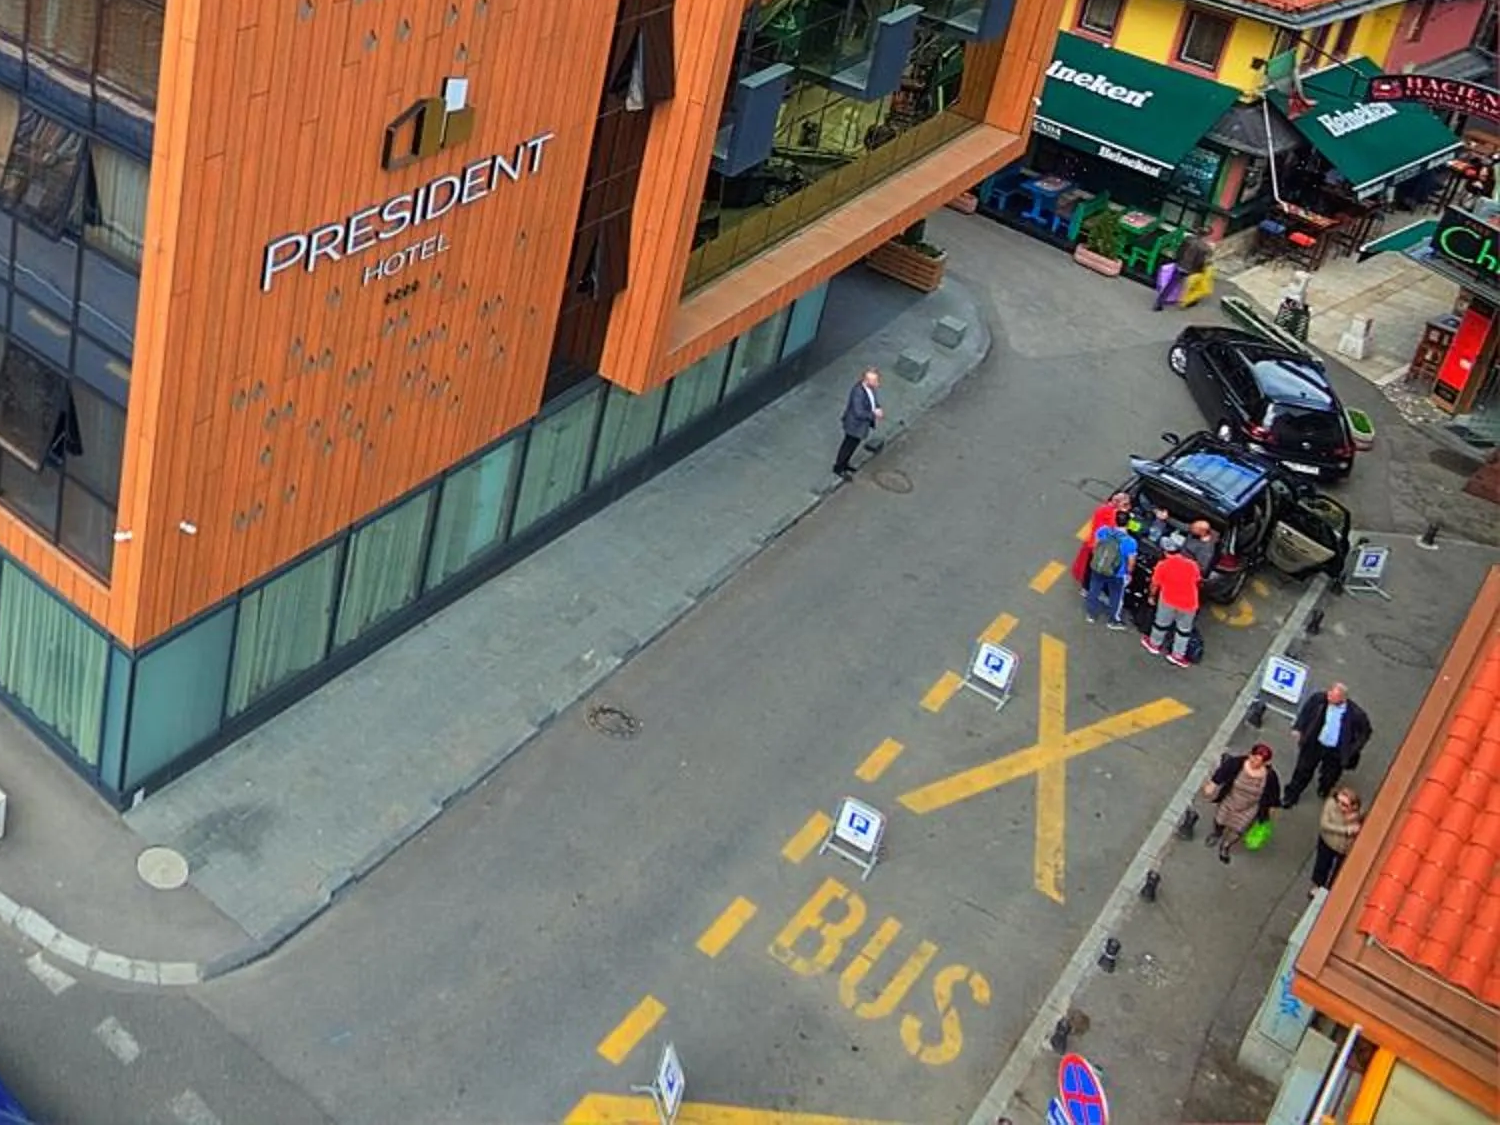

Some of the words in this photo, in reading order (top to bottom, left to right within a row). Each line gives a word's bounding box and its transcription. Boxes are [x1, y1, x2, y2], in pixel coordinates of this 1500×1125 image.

[1317, 102, 1398, 137] Heineken
[1098, 146, 1162, 178] Heineken
[260, 131, 555, 293] PRESIDENT
[362, 233, 451, 287] HOTEL
[1441, 226, 1500, 273] Ch
[768, 877, 992, 1066] BUS
